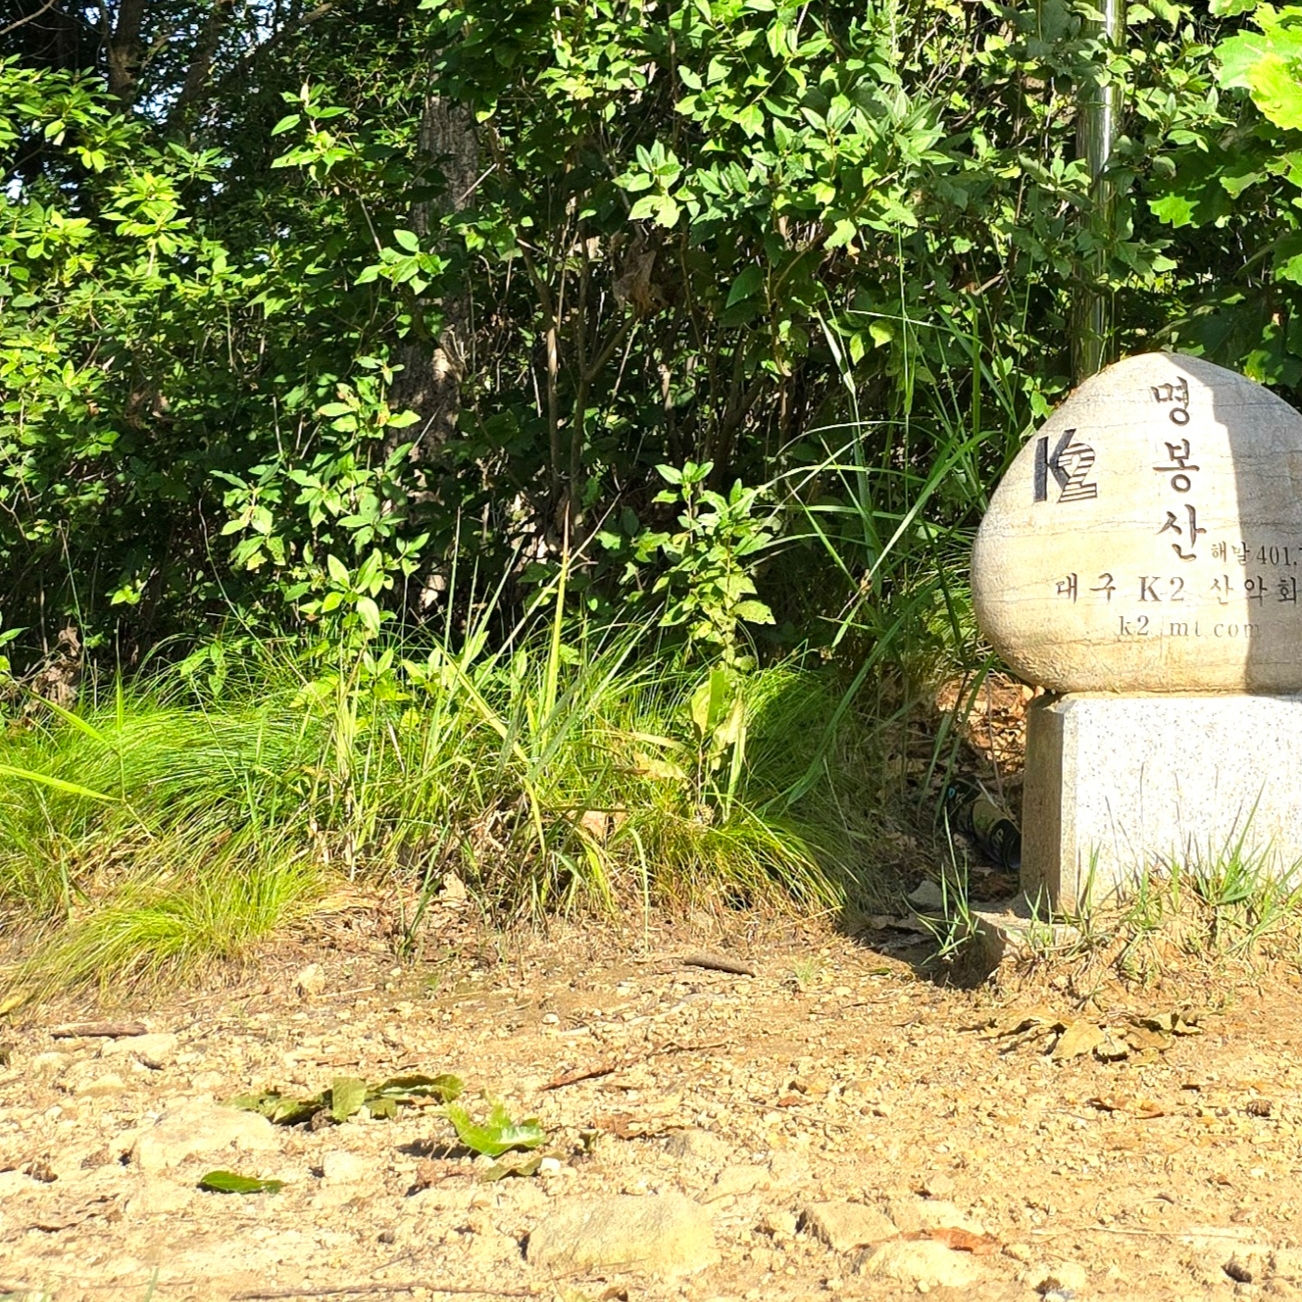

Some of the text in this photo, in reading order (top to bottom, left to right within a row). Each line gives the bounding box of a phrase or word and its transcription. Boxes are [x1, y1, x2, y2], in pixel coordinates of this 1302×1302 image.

[1034, 428, 1098, 503] K2
[1151, 376, 1207, 562] 명봉산
[1210, 540, 1251, 566] 해발
[1055, 572, 1299, 607] 대구 K2 산악회
